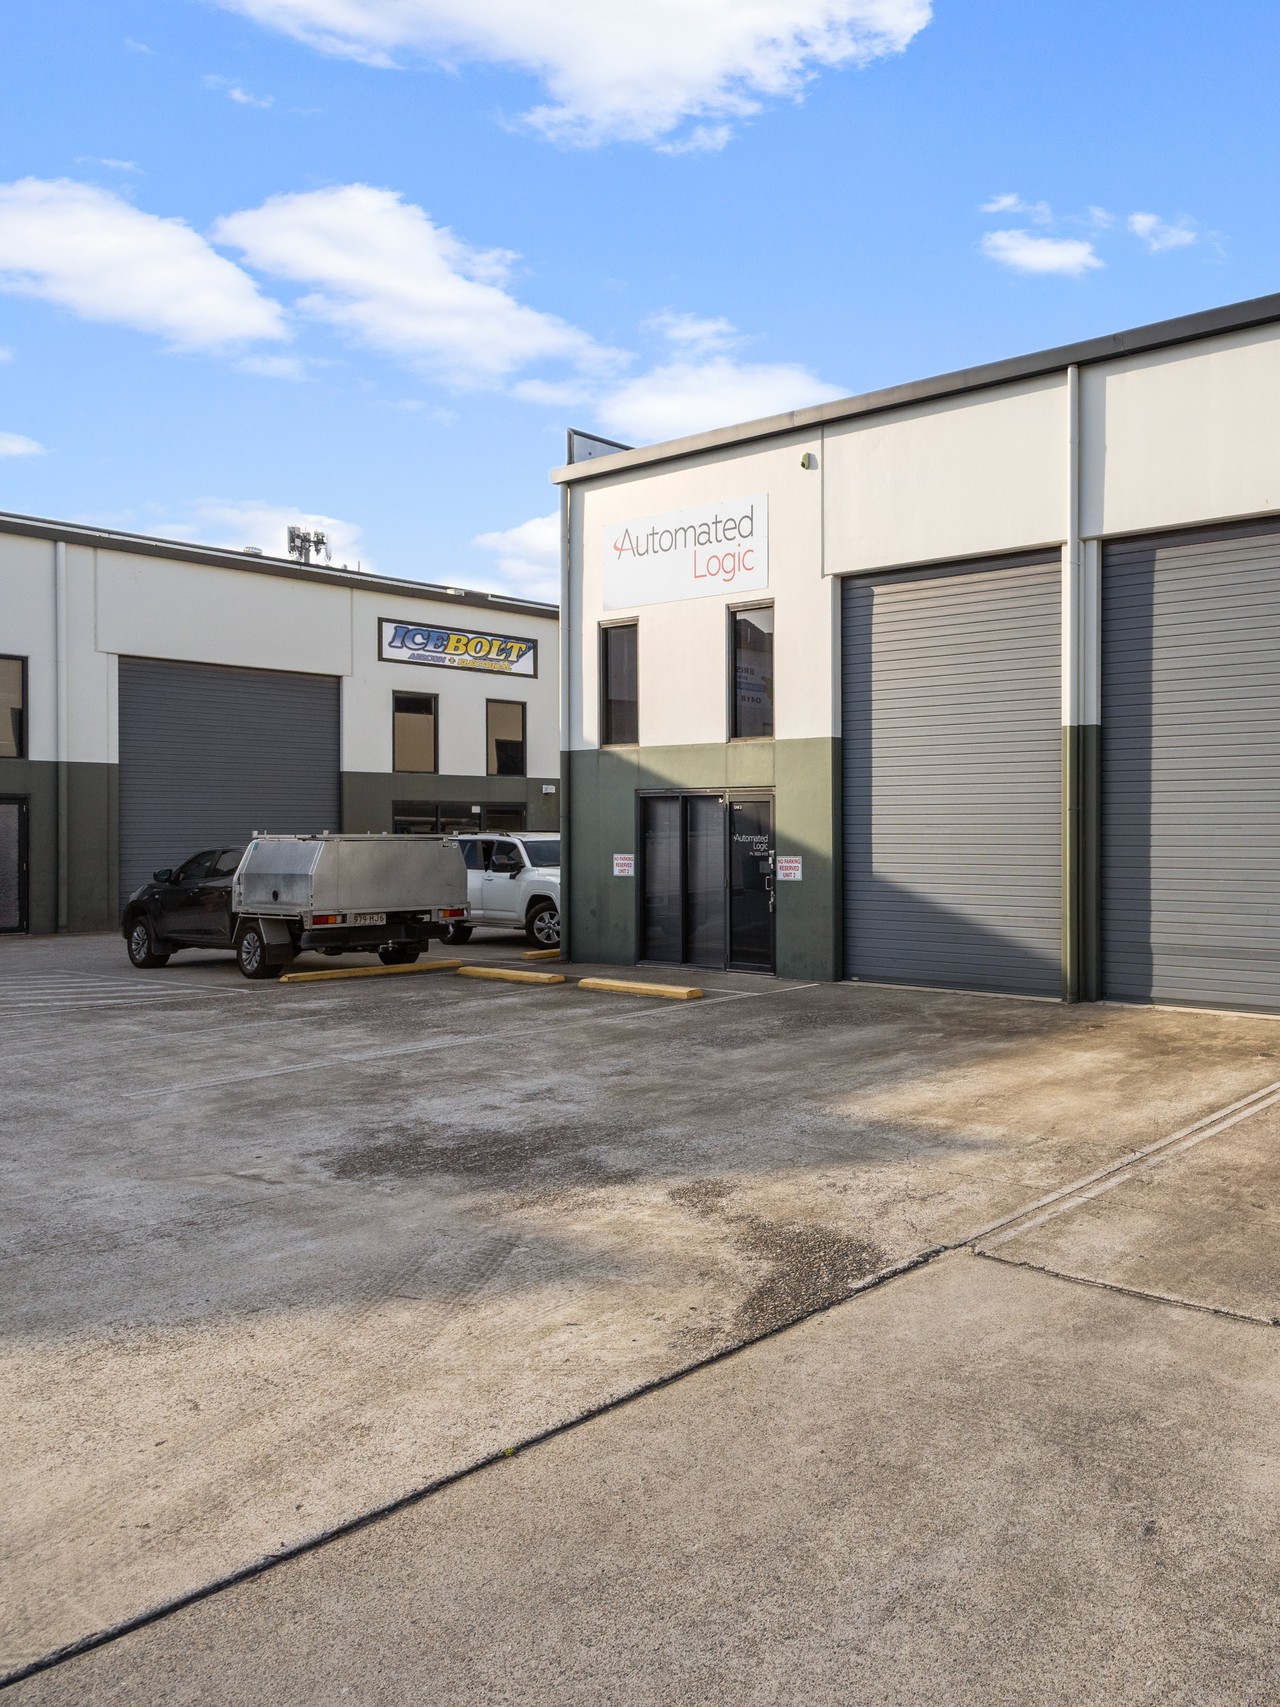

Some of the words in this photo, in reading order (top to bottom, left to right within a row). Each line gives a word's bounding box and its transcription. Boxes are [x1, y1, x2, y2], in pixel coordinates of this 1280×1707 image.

[613, 504, 754, 560] Automated
[693, 543, 755, 582] Logic
[388, 625, 527, 663] ICEBOLT
[733, 834, 769, 842] Automated
[753, 842, 768, 851] Logic
